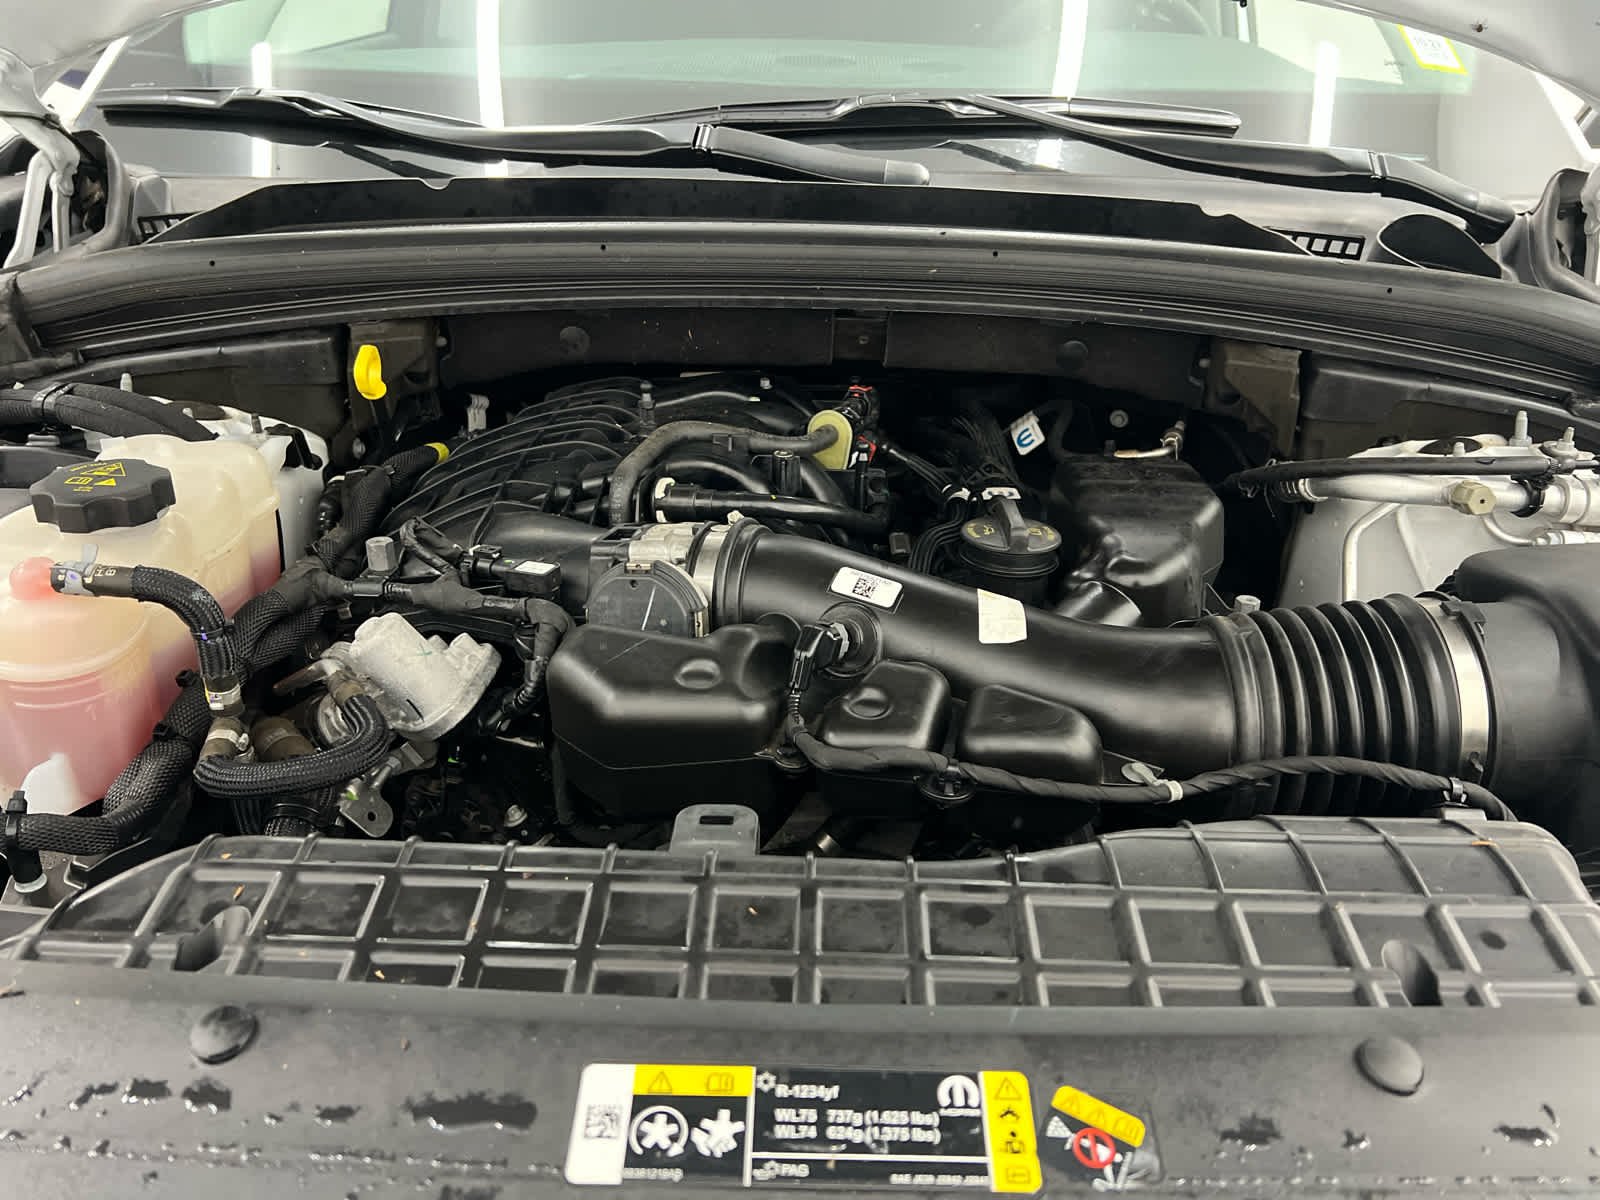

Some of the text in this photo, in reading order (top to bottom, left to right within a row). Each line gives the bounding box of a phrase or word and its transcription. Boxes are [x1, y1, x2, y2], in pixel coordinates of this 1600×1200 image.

[775, 1084, 840, 1102] R-1234yf
[774, 1108, 818, 1122] WL75
[826, 1109, 863, 1127] 737g
[911, 1111, 940, 1128] lbs)
[773, 1125, 818, 1139] WL74
[911, 1128, 941, 1145] lbs)
[781, 1163, 810, 1178] PAG
